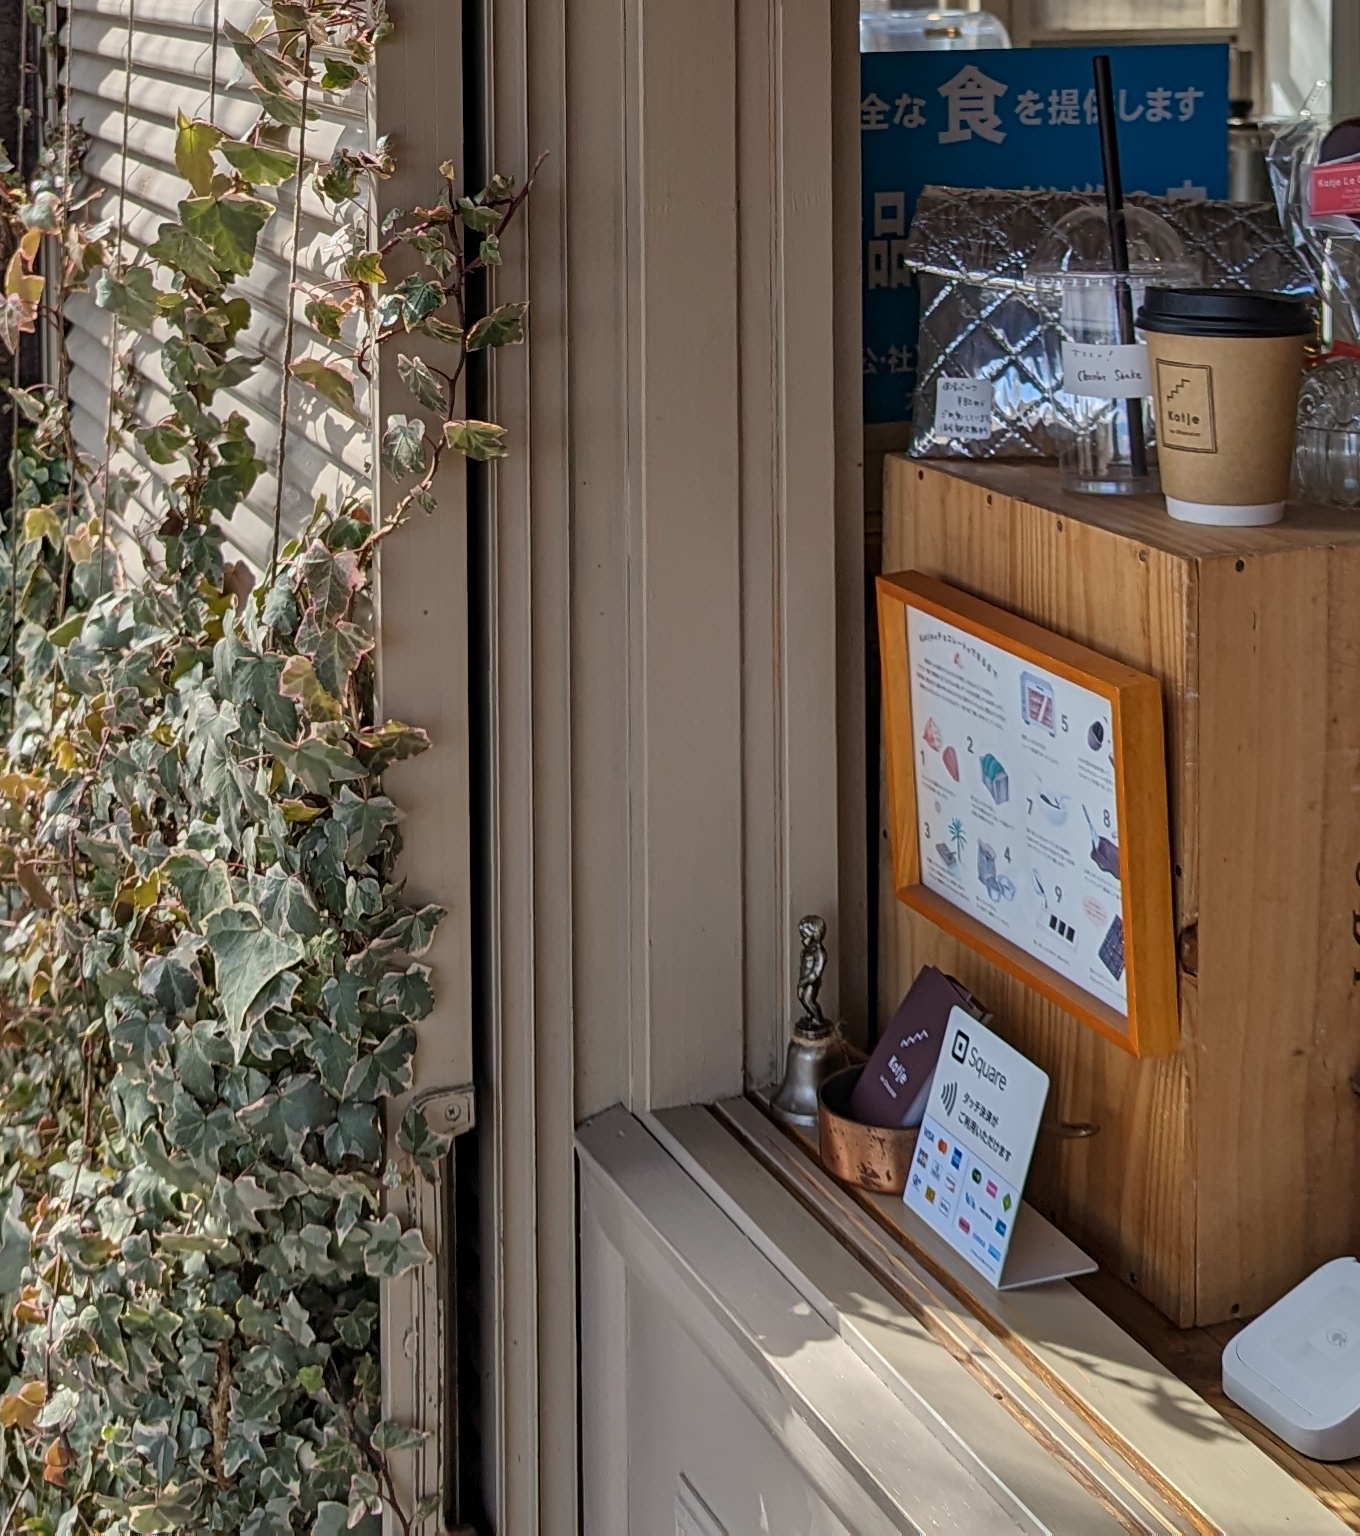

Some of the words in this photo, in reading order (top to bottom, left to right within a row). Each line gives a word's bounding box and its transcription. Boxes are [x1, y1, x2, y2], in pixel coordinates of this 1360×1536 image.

[1317, 177, 1341, 188] Katje
[1343, 175, 1355, 186] Le
[1167, 410, 1200, 426] Katje
[1061, 713, 1069, 733] 5
[966, 735, 975, 754] 2
[1025, 798, 1033, 815] 7
[1102, 808, 1111, 828] 8
[923, 821, 931, 839] 3
[1003, 846, 1011, 864] 4
[1054, 885, 1062, 904] 9
[968, 1046, 1008, 1092] Square
